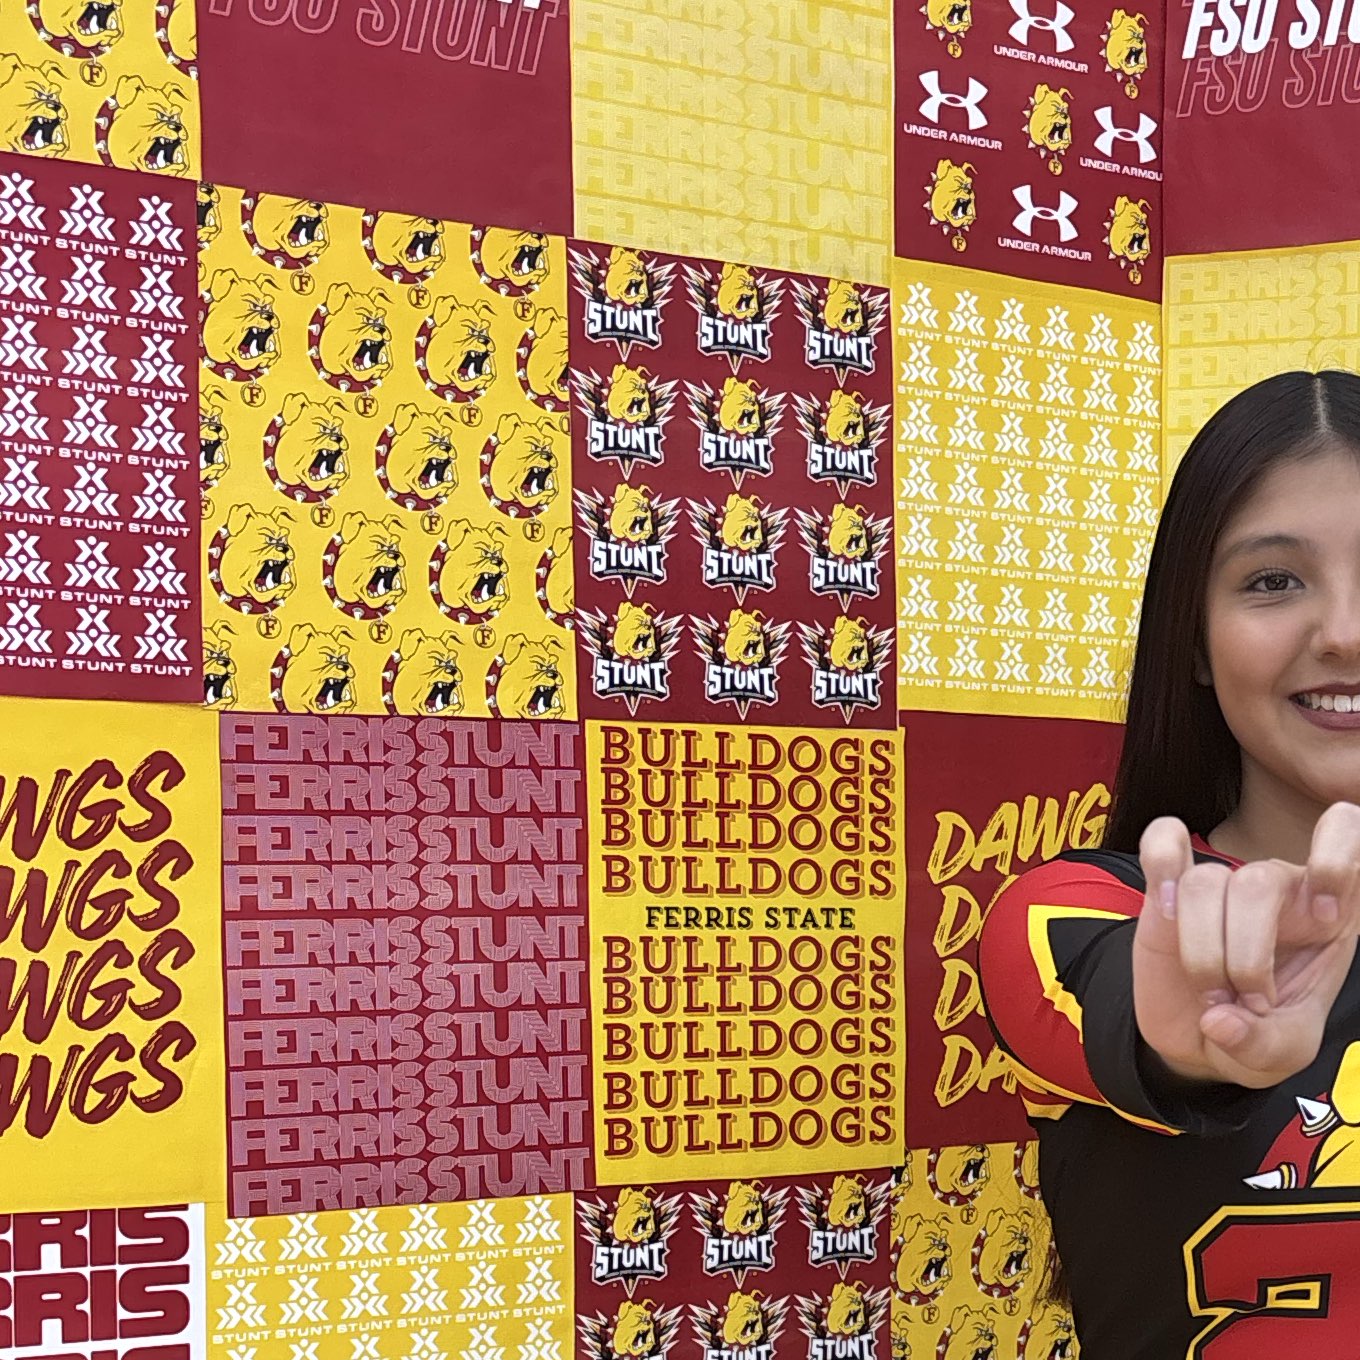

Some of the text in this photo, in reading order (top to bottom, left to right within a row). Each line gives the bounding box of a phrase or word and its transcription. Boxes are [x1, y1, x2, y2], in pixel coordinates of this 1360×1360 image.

[993, 45, 1089, 73] UNDER ARMOUR
[903, 123, 1002, 150] UNDER ARMOUR
[1080, 157, 1163, 181] UNDER ARMOU
[0, 229, 188, 266] TUNT STUNT STUNT
[998, 237, 1092, 261] UNDER ARMOUR
[588, 302, 656, 336] STUNT
[701, 317, 767, 350] STUNT
[808, 328, 872, 362] STUNT
[0, 442, 189, 469] TUNT STUNT STUNT
[593, 540, 664, 574] STUNT
[706, 549, 771, 582] STUNT
[813, 558, 876, 590] STUNT
[601, 727, 896, 777] BULLDOGS
[0, 750, 186, 862] WGS
[601, 769, 894, 816] BULLDOGS
[601, 809, 894, 855] BULLDOGS
[927, 782, 1111, 884] DAWG
[602, 855, 896, 897] BULLDOGS
[0, 839, 194, 953] WGS
[646, 907, 855, 930] FERRIS STATE
[603, 935, 896, 977] BULLDOGS
[0, 928, 195, 1044] WGS
[604, 975, 896, 1017] BULLDOGS
[604, 1017, 896, 1063] BULLDOGS
[0, 1020, 197, 1139] WGS
[604, 1063, 896, 1112] BULLDOGS
[604, 1105, 897, 1158] BULLDOGS
[704, 1231, 771, 1265] STUNT
[809, 1224, 876, 1255] STUNT
[212, 1245, 564, 1279] STUNT STUNT STUNT STUNT STUNT STUNT
[594, 1243, 666, 1278] STUNT
